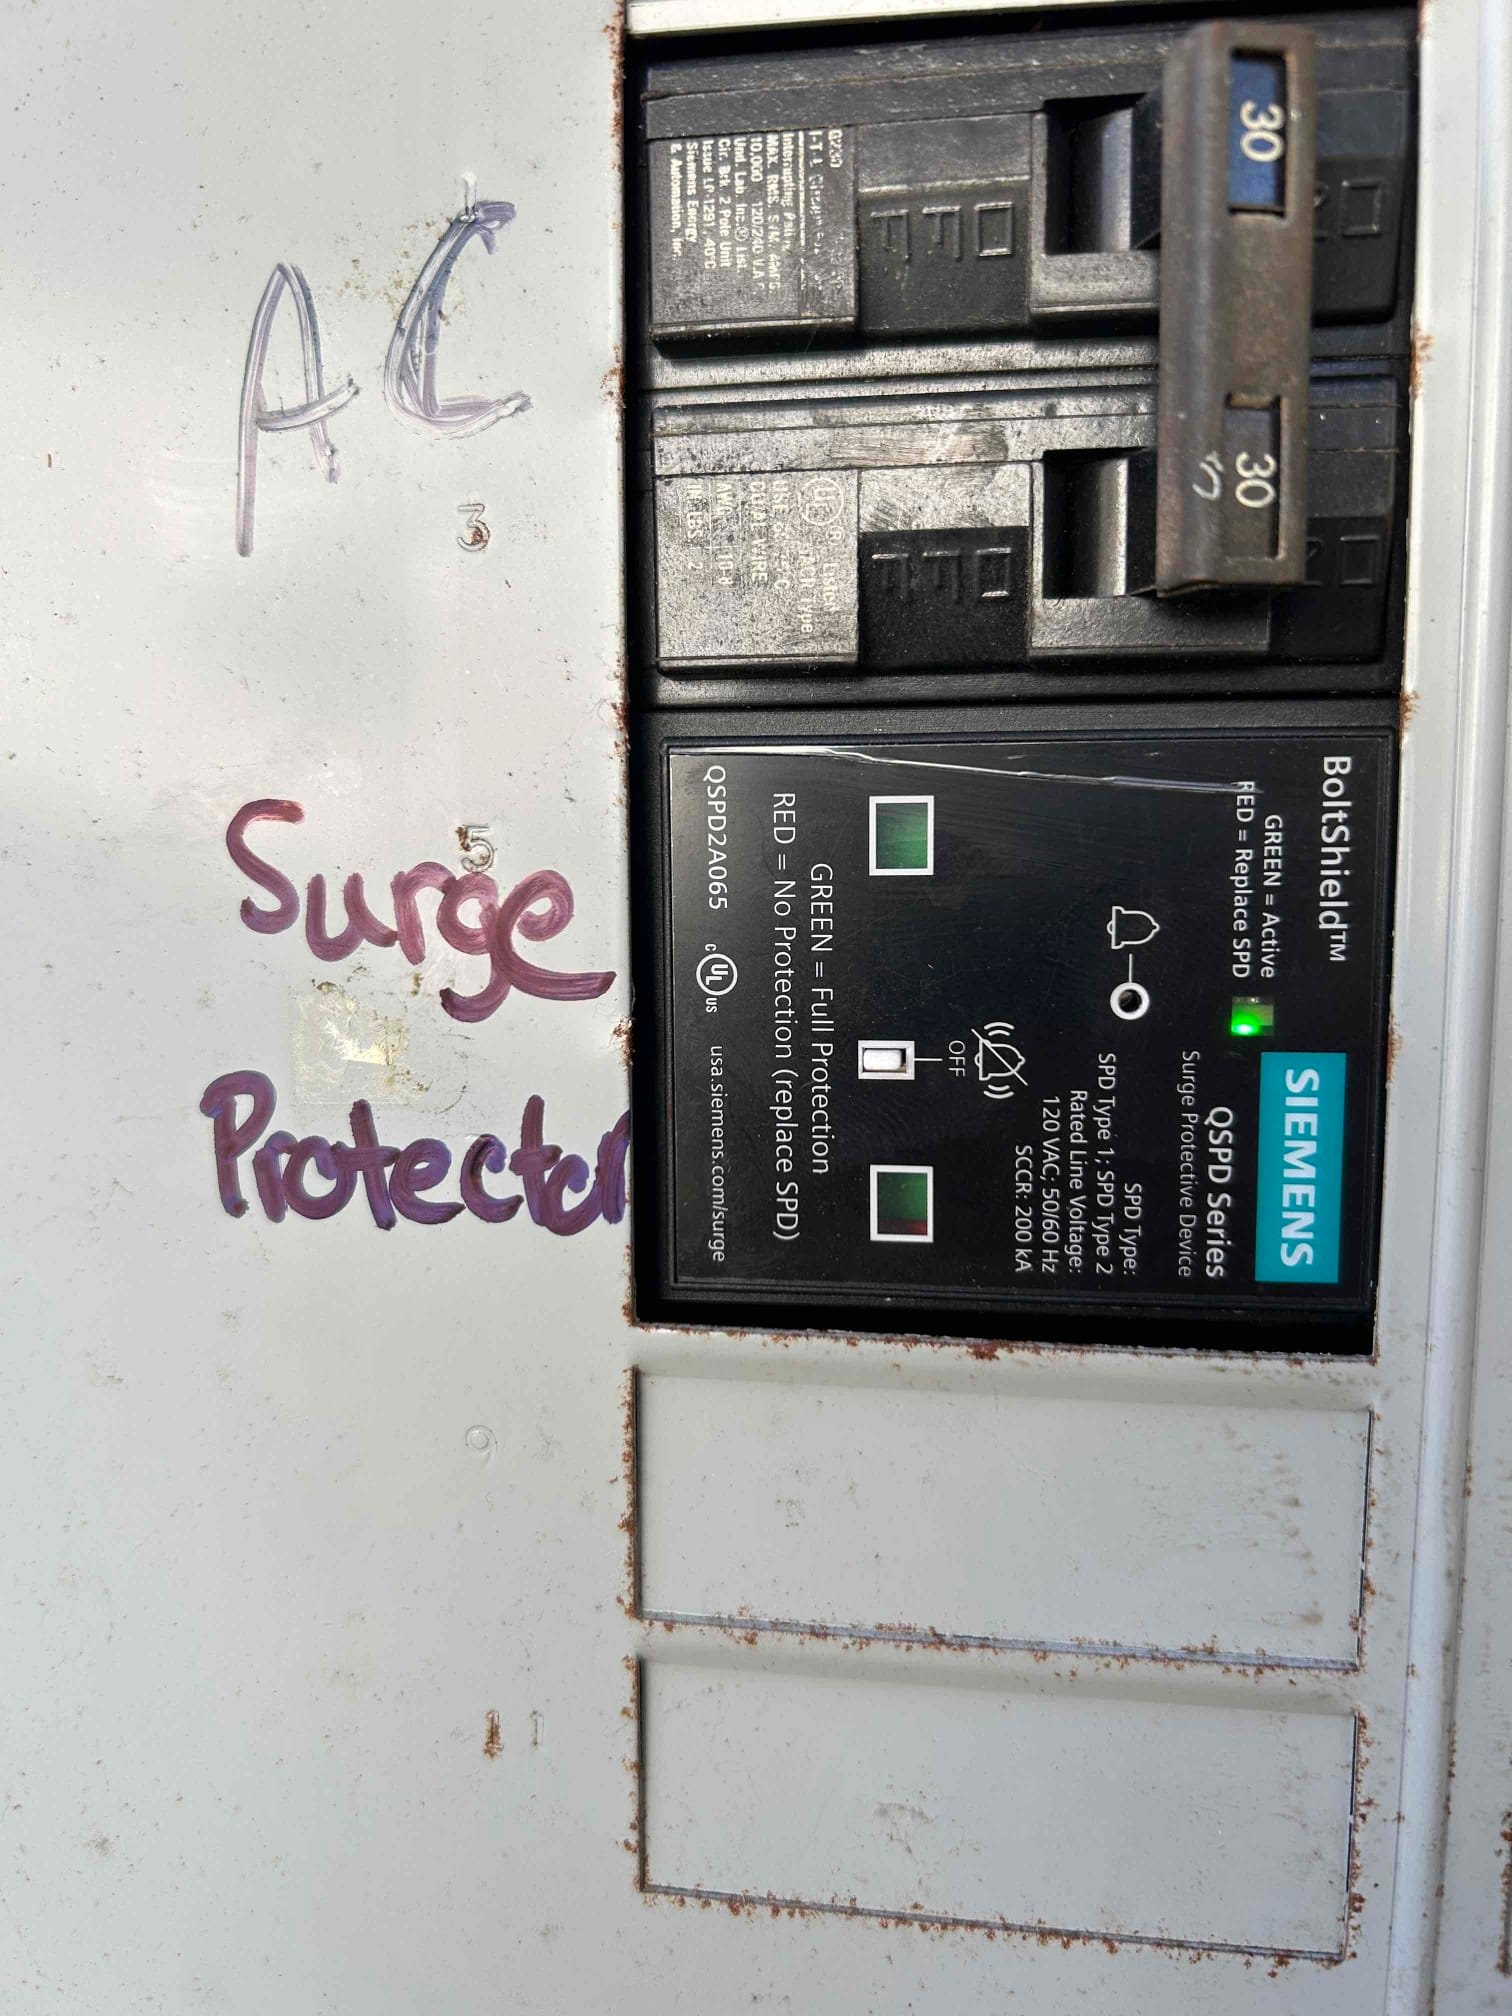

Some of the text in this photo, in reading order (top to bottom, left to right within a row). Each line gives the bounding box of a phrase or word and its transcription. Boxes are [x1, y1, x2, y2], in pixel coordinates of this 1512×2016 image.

[671, 144, 681, 153] &
[703, 141, 714, 172] Issue
[718, 139, 730, 160] Cir.
[734, 138, 747, 166] Und.
[750, 137, 763, 182] 10,000
[767, 135, 778, 167] MAX.
[1240, 99, 1284, 162] 30
[670, 160, 682, 233] Automation,
[685, 143, 698, 242] Siemens Energy
[735, 172, 747, 196] Lab.
[767, 175, 779, 207] RMS.
[781, 133, 794, 206] Interrupting
[720, 197, 730, 205] 2
[720, 210, 731, 237] Pole
[751, 202, 763, 253] 120/240
[721, 242, 732, 267] Unit
[1234, 451, 1276, 508] 30
[456, 502, 491, 553] 3
[773, 793, 795, 844] RED
[1235, 782, 1254, 822] RED
[455, 822, 496, 873] 5
[705, 765, 727, 910] QSPD2A065
[1263, 814, 1282, 886] GREEN
[225, 798, 618, 1024] Surge
[773, 880, 795, 916] No
[810, 863, 834, 952] GREEN
[1230, 848, 1252, 933] Replace
[1232, 938, 1250, 978] SPD
[1260, 912, 1280, 978] Active
[774, 927, 797, 1059] Protection
[811, 988, 834, 1032] Full
[949, 1040, 966, 1076] OFF
[769, 1068, 800, 1172] (replace
[811, 1042, 834, 1174] Protection
[708, 1045, 728, 1262] usa.siemens.com/surge
[1039, 1095, 1059, 1272] 120 VAC; 50/60 Hz
[1064, 1090, 1087, 1273] Rated Line Voltage:
[1093, 1053, 1114, 1274] SPD Type 1; SPD Type 2
[1177, 1050, 1199, 1277] Surge Protective Device
[1281, 1067, 1320, 1267] SIEMENS
[770, 1181, 800, 1241] SPD)
[1015, 1145, 1033, 1272] SCCR: 200 kA
[1205, 1106, 1233, 1278] QSPD Series
[1121, 1183, 1141, 1275] SPD Type:
